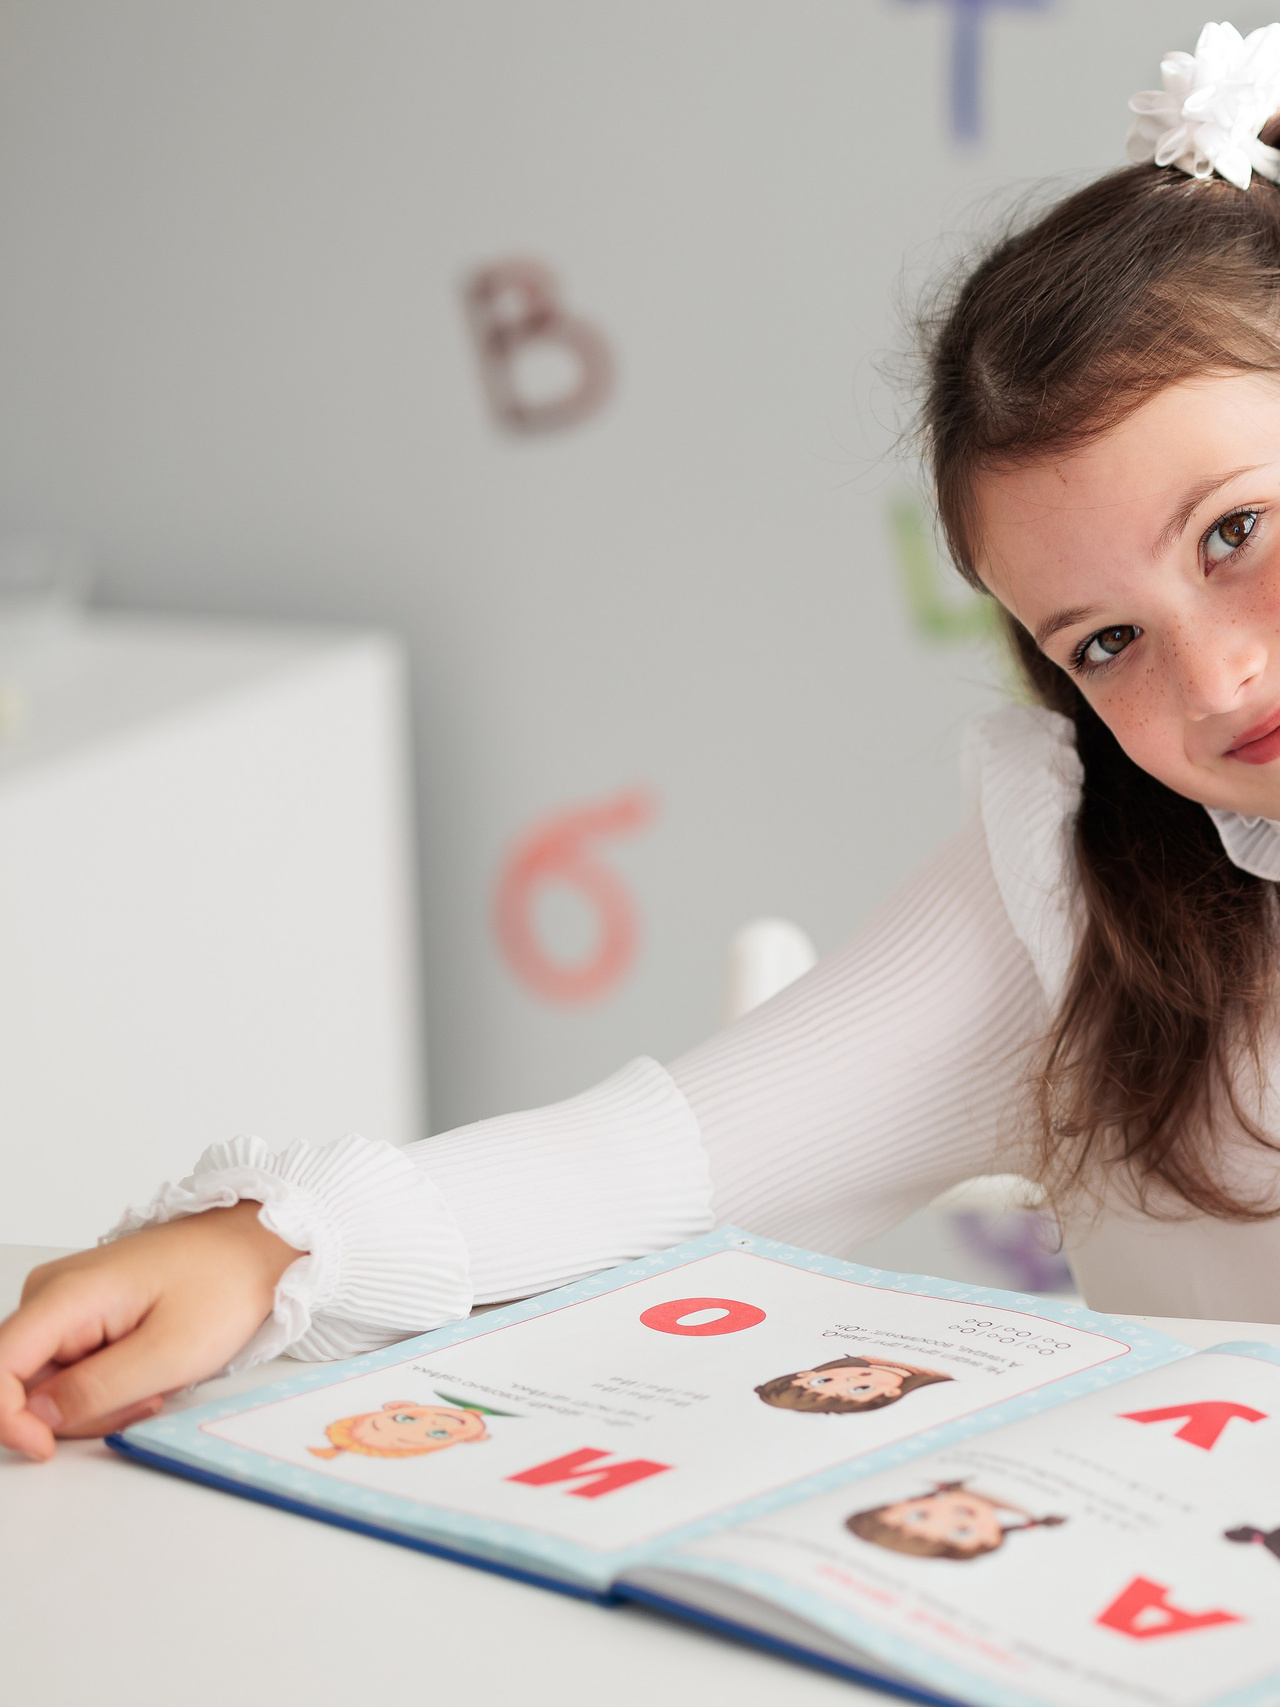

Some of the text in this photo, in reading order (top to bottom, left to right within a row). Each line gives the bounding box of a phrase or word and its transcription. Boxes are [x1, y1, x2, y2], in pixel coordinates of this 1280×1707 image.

[639, 1297, 767, 1337] О
[1117, 1400, 1269, 1451] У
[504, 1446, 674, 1499] И
[1094, 1574, 1244, 1641] А
